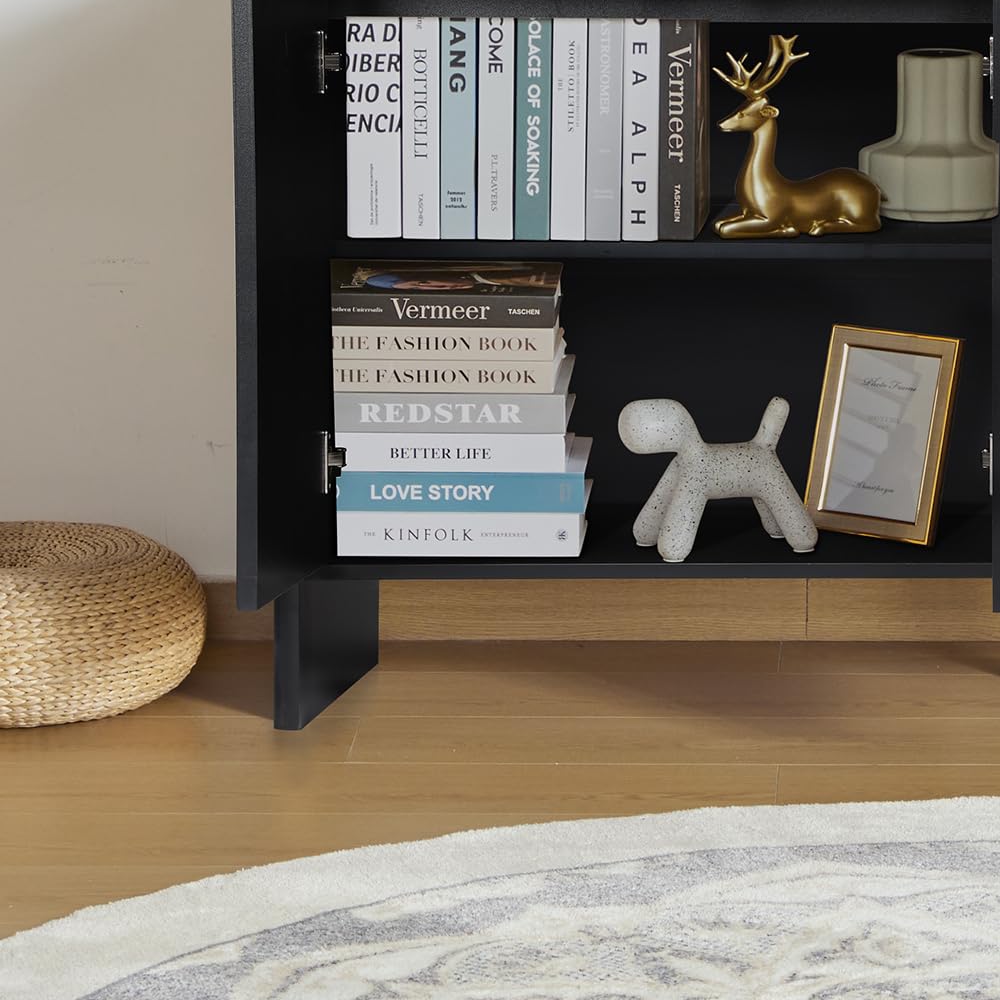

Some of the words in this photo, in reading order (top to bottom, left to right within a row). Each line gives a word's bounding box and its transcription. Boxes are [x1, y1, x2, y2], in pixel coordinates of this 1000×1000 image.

[347, 23, 376, 42] RA
[382, 23, 401, 42] D
[527, 18, 542, 78] OLACE
[413, 48, 427, 159] BOTTICELLI
[527, 84, 541, 109] OF
[667, 44, 692, 163] Vermeer
[526, 115, 540, 196] SOAKING
[631, 121, 647, 225] ALPH
[390, 297, 490, 320] Vermeer
[377, 336, 471, 351] FASHION
[479, 336, 537, 351] BOOK
[376, 368, 471, 383] FASHION
[478, 369, 537, 384] BOOK
[359, 403, 522, 424] REDSTAR
[390, 448, 451, 459] BETTER
[456, 448, 492, 460] LIFE
[370, 484, 423, 500] LOVE
[428, 485, 494, 500] STORY
[384, 528, 474, 541] KINFOLK
